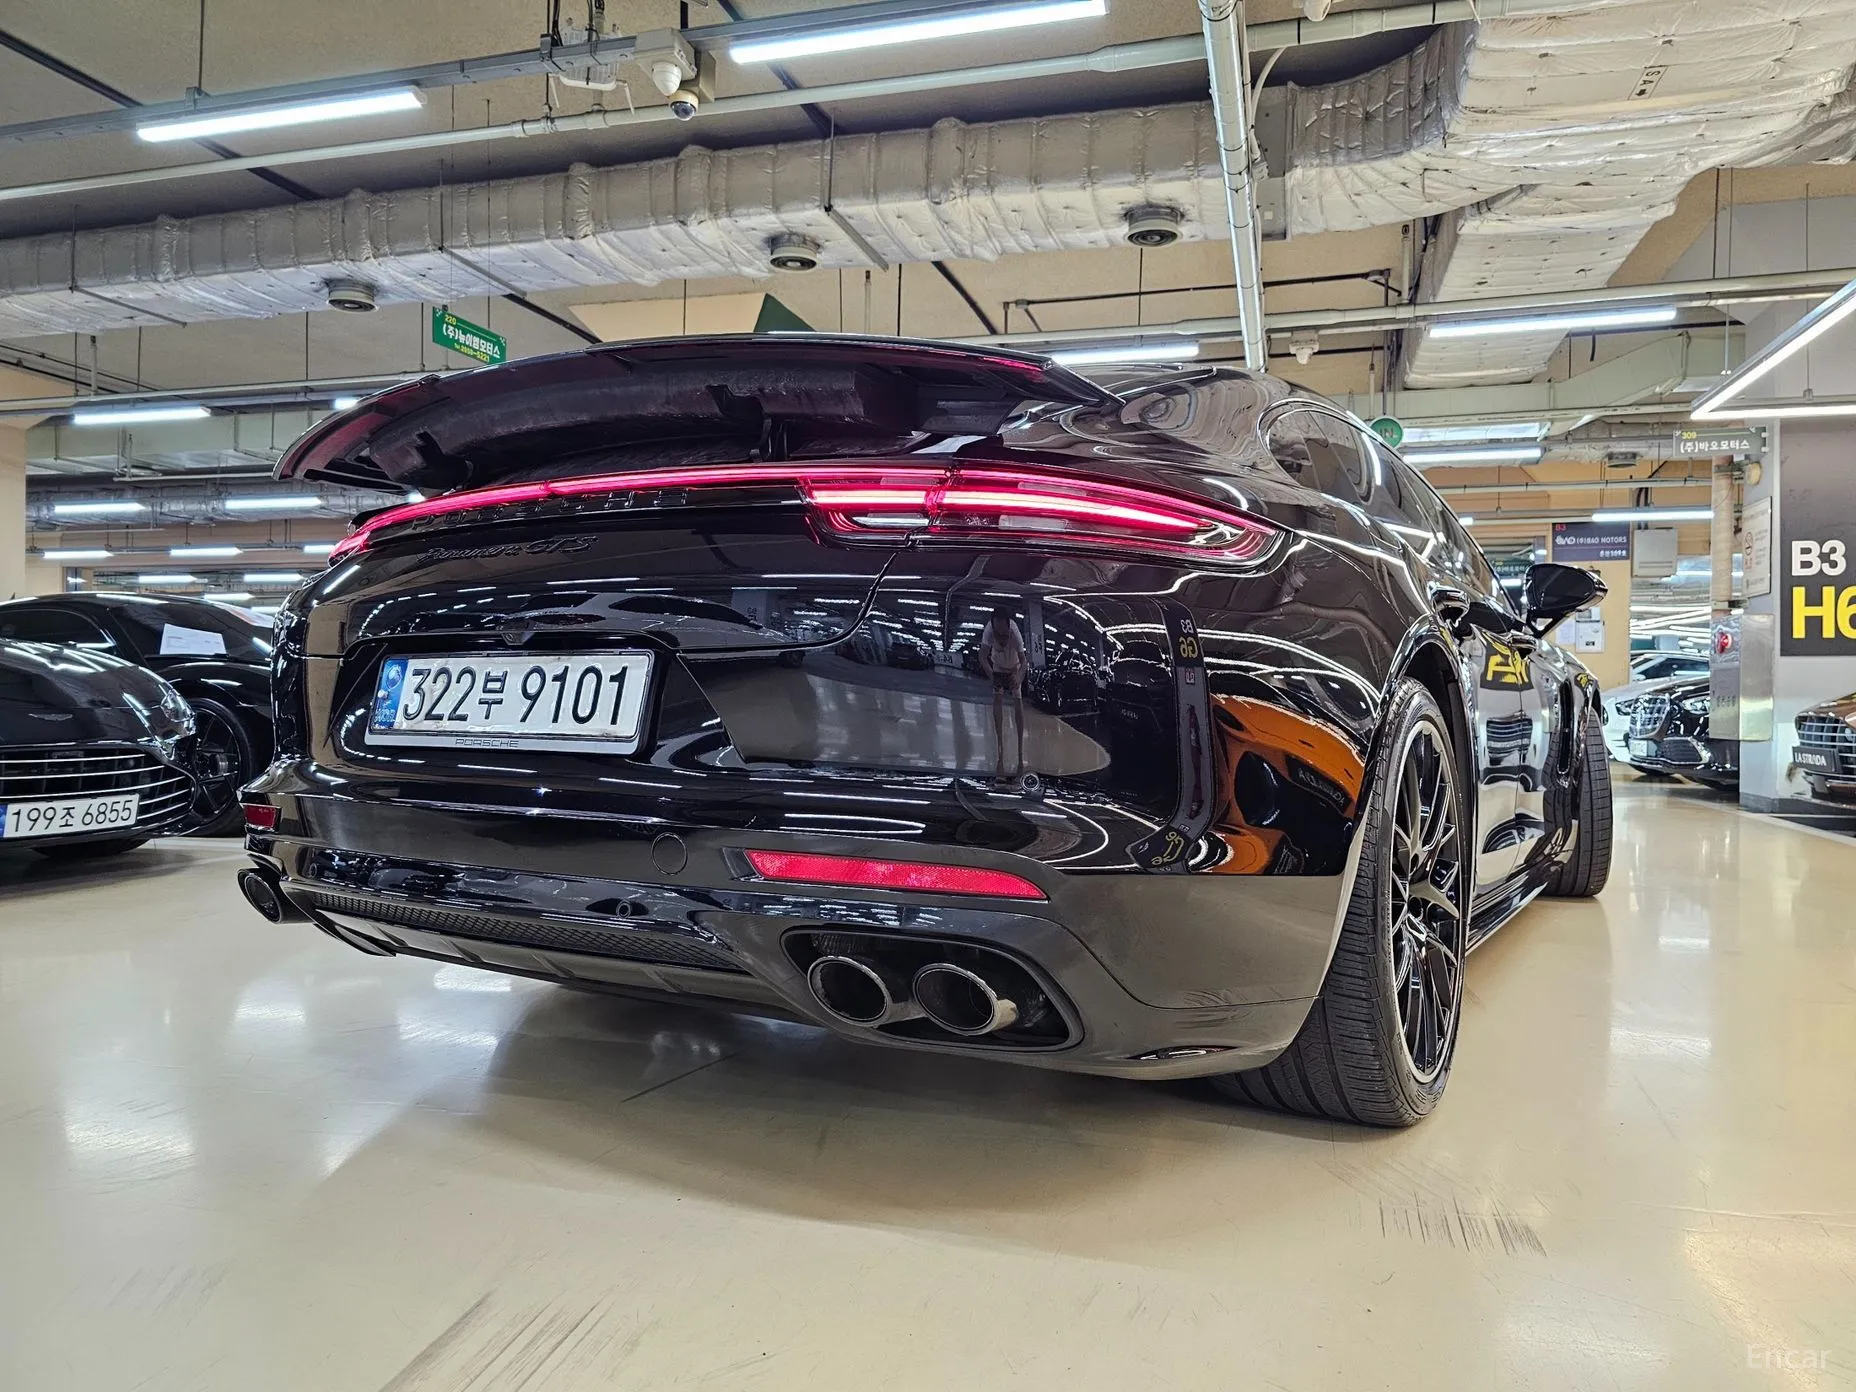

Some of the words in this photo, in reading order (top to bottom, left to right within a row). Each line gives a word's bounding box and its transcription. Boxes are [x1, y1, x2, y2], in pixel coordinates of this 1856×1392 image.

[1680, 431, 1697, 440] 309
[1680, 439, 1751, 454] (주)바오모터스
[523, 534, 600, 555] GTS
[1600, 536, 1627, 545] MOTORS
[1791, 539, 1847, 577] B3
[1792, 584, 1856, 640] H6
[403, 665, 510, 722] 322부
[519, 665, 629, 726] 9101
[455, 737, 520, 749] PORSCHE
[11, 805, 76, 833] 199조
[81, 799, 134, 826] 6855
